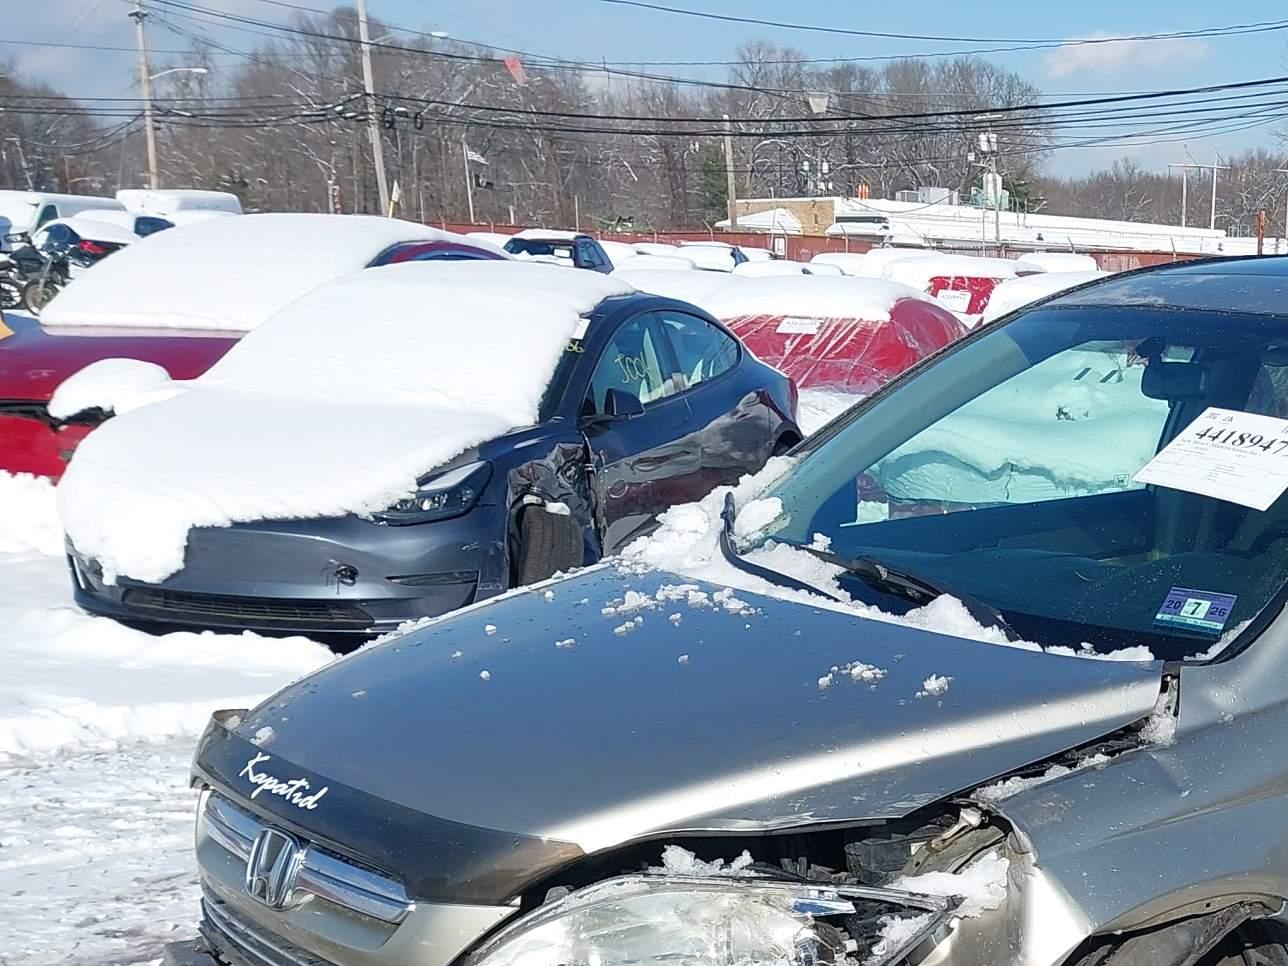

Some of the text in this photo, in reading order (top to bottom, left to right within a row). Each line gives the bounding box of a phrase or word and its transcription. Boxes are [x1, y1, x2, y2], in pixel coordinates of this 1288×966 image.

[1165, 599, 1226, 617] 20 7 26
